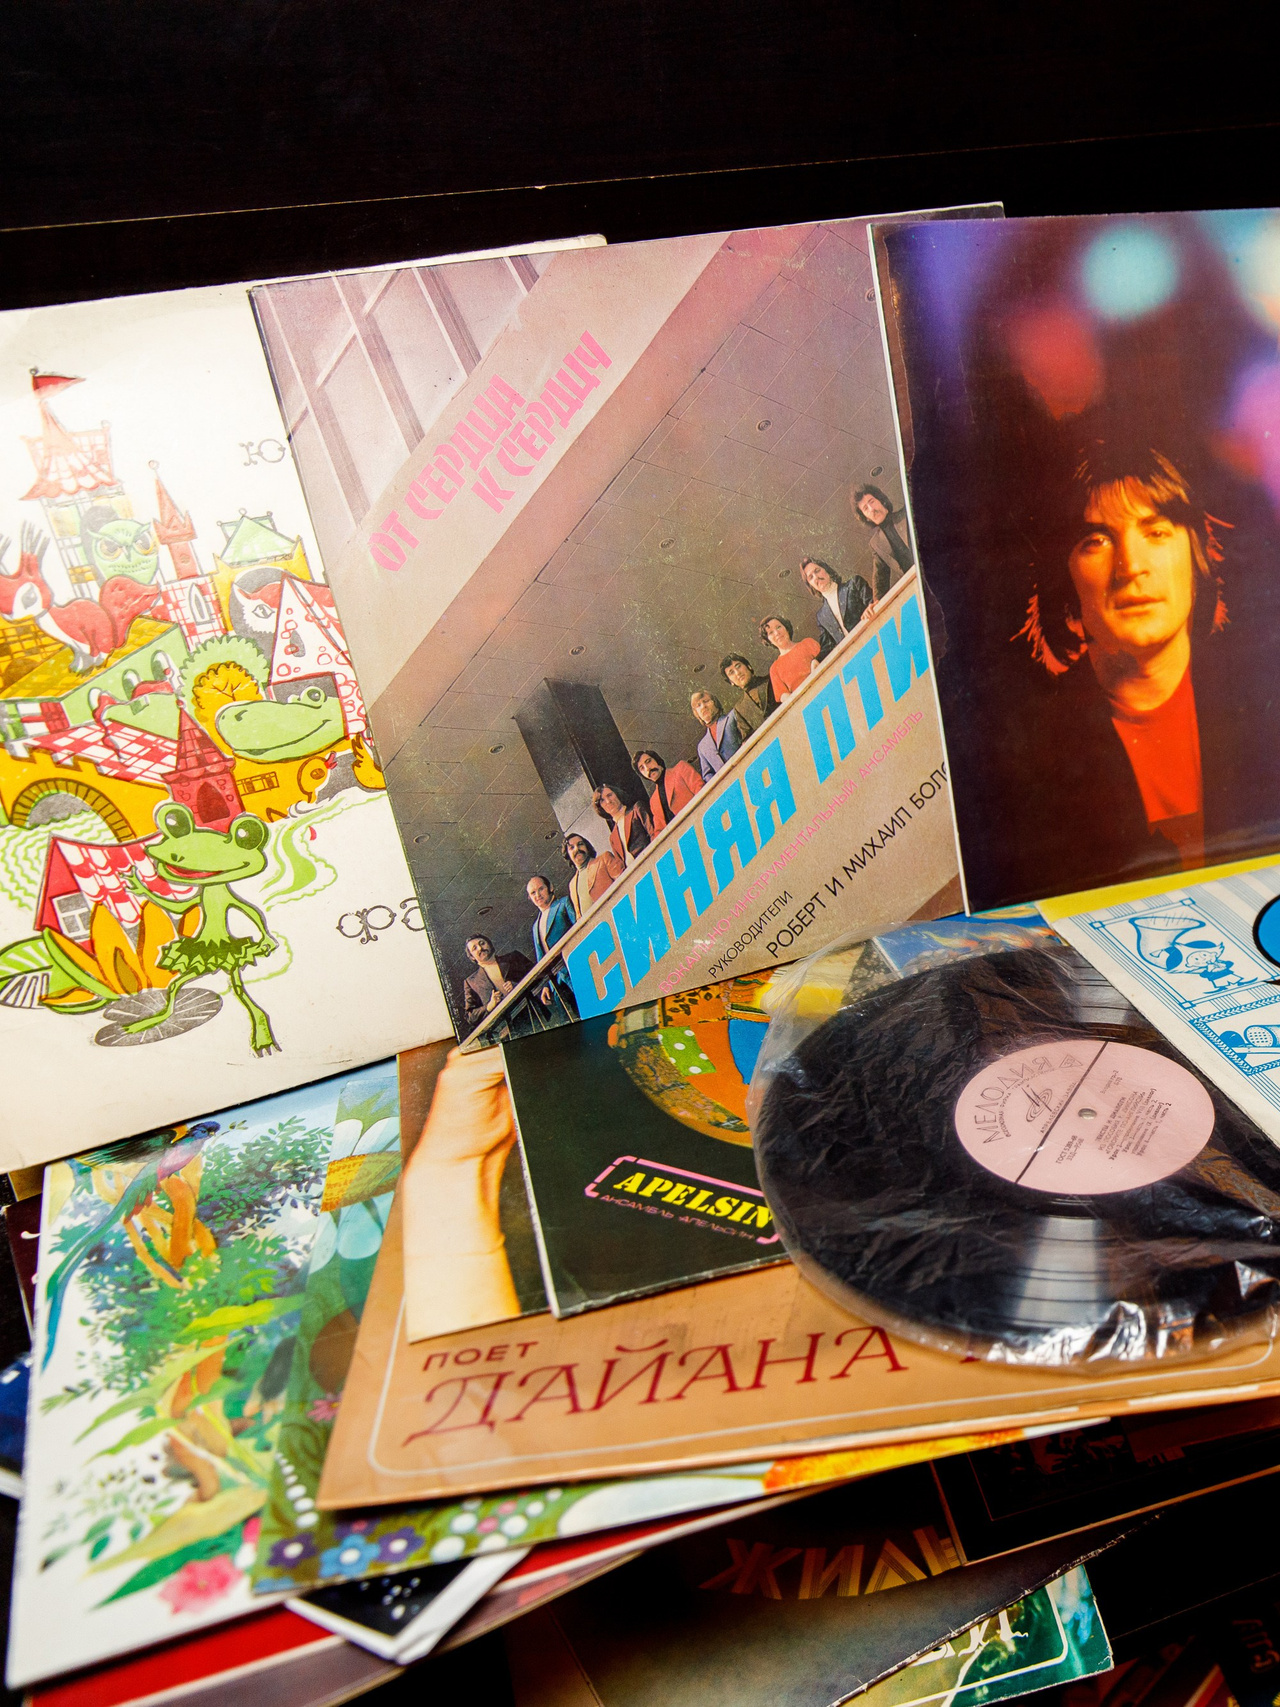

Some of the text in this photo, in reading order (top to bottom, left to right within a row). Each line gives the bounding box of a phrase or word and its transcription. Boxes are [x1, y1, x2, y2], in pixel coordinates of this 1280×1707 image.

[367, 373, 527, 572] ОТ СЕРДЦА
[470, 329, 613, 514] К СЕРДЦУ
[566, 593, 931, 1019] СИНЯЯ ПТИ
[658, 708, 925, 996] ВОКАЛЬНО-ИНСТРУМЕНТАЛЬНЫЙ АНСАМБЛЬ
[707, 889, 794, 980] РУКОВОДИТЕЛИ
[766, 895, 828, 959] РОБЕРТ
[828, 876, 846, 898] И
[842, 806, 915, 883] МИХАИЛ
[973, 1056, 1053, 1146] МЕЛОДИЯ
[600, 1193, 675, 1220] АНСАМБЛЬ
[612, 1171, 774, 1229] APELSIN
[400, 1325, 910, 1449] ДАЙАНА
[422, 1340, 540, 1372] ПОЕТ
